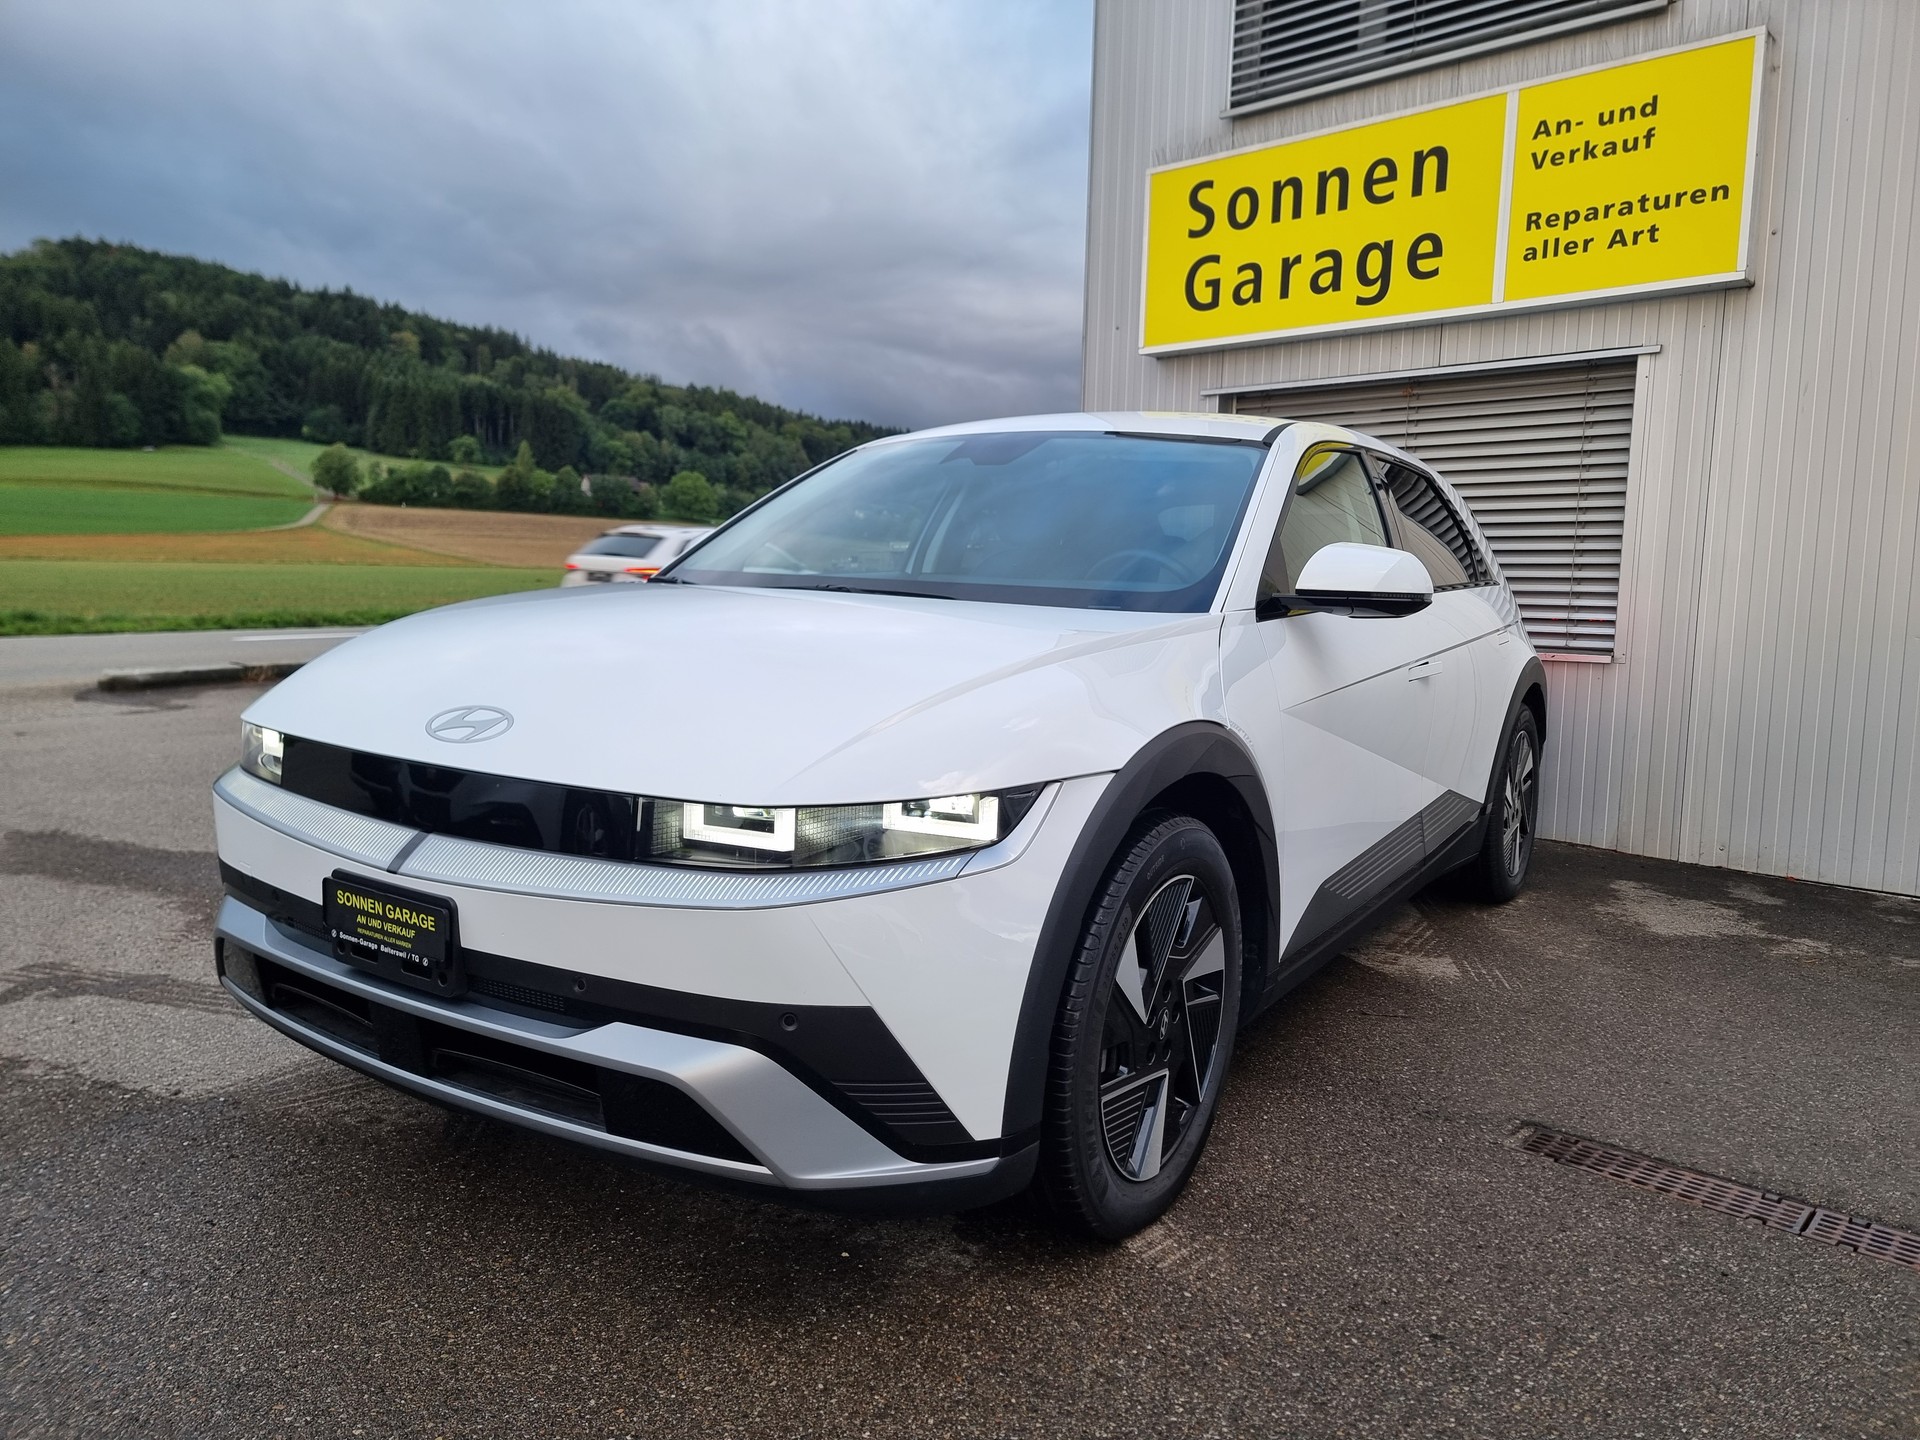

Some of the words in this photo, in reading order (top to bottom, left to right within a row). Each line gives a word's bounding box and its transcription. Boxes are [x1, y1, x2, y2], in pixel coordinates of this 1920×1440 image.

[1532, 118, 1585, 141] An-
[1598, 94, 1659, 128] und
[1531, 126, 1656, 170] Verkauf
[1187, 144, 1450, 240] Sonnen
[1525, 184, 1730, 232] Reparaturen
[1522, 237, 1595, 262] aller
[1607, 224, 1660, 249] Art
[1184, 231, 1444, 312] Garage
[336, 889, 383, 916] SONNEN
[385, 904, 436, 931] GARAGE
[356, 914, 367, 924] AN
[367, 917, 382, 929] UND
[383, 922, 416, 939] VERKAUF
[339, 931, 378, 950] Sonnen-Garage
[411, 954, 420, 963] TG
